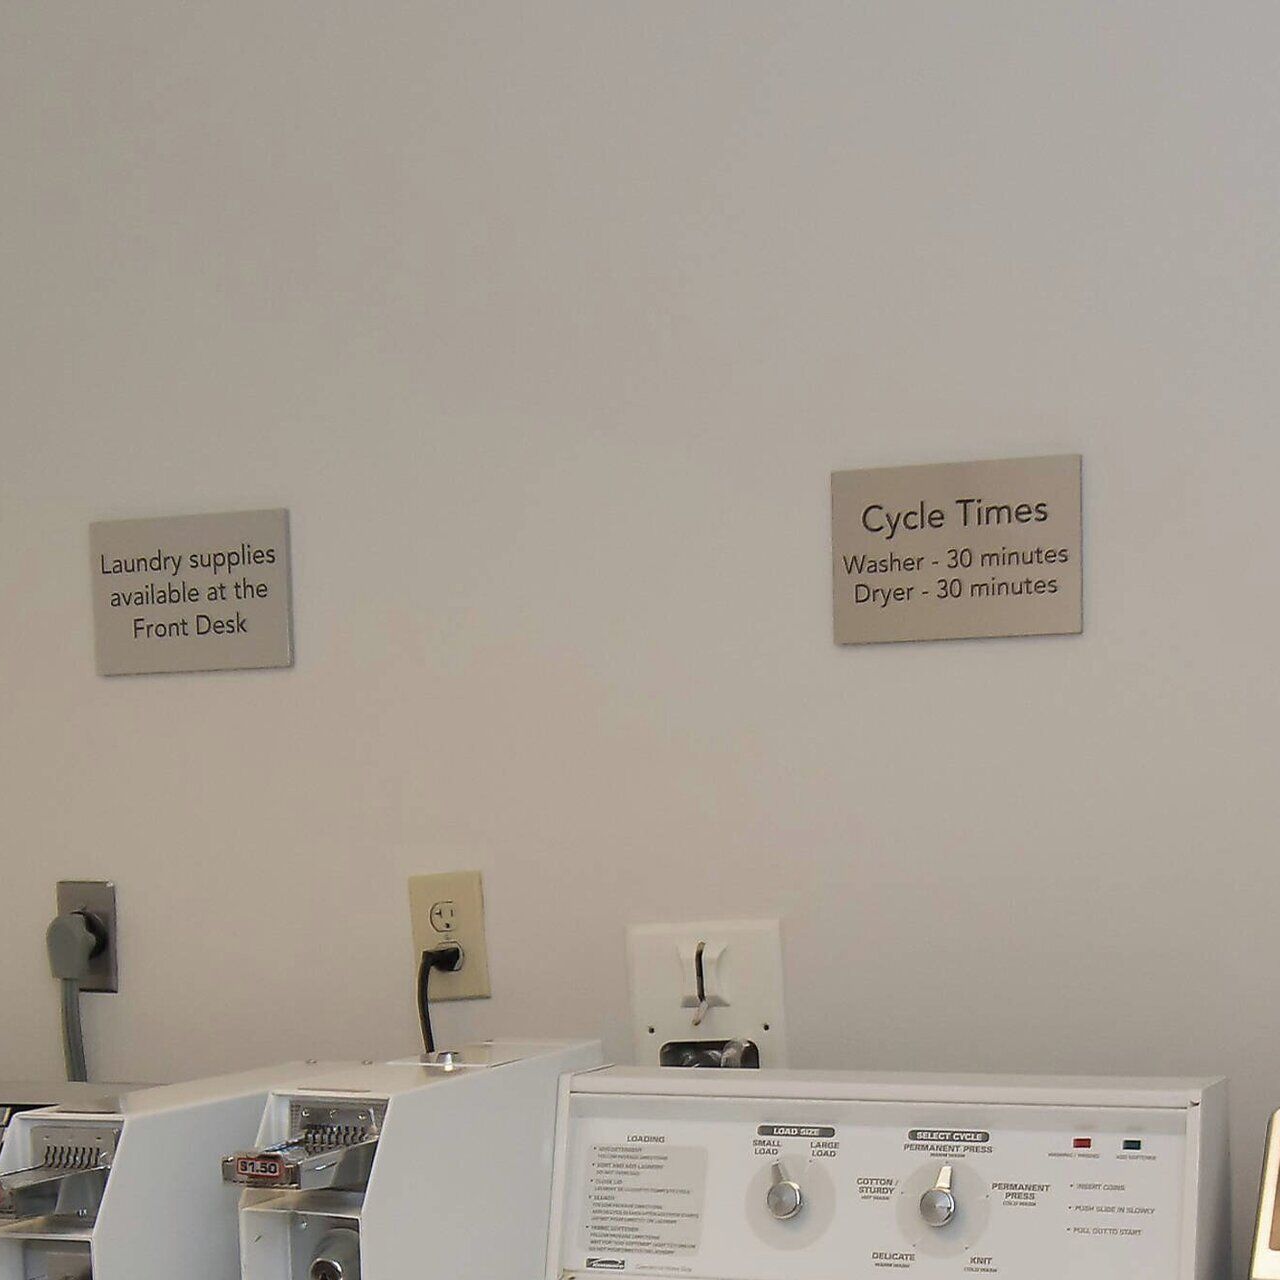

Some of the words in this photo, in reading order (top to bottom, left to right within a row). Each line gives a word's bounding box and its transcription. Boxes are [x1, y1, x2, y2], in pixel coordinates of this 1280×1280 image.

[861, 501, 945, 540] Cycle
[956, 498, 1049, 527] Times
[101, 549, 182, 576] Laundry
[189, 543, 276, 575] supplies
[843, 552, 925, 575] Washer
[946, 548, 973, 569] 30
[980, 546, 1069, 567] minutes
[110, 581, 199, 607] available
[207, 582, 226, 601] at
[234, 577, 268, 600] the
[854, 584, 914, 608] Dryer
[936, 578, 962, 599] 30
[970, 577, 1058, 597] minutes
[133, 618, 189, 639] Front
[196, 612, 248, 636] Desk
[773, 1127, 798, 1136] LOAD
[799, 1128, 820, 1136] SIZE
[916, 1131, 952, 1140] SELECT
[953, 1132, 983, 1141] CYCLE
[627, 1135, 665, 1143] LOADING
[753, 1139, 782, 1147] SMALL
[810, 1141, 840, 1149] LARGE
[903, 1143, 960, 1152] PERMANENT
[963, 1145, 993, 1153] PRESS
[240, 1160, 277, 1174] $1.50
[856, 1178, 893, 1186] COTTON
[992, 1182, 1050, 1191] PERMANENT
[858, 1186, 895, 1195] STURDY
[1005, 1192, 1035, 1200] PRESS
[871, 1252, 916, 1261] DELICATE
[970, 1257, 993, 1265] KNIT
